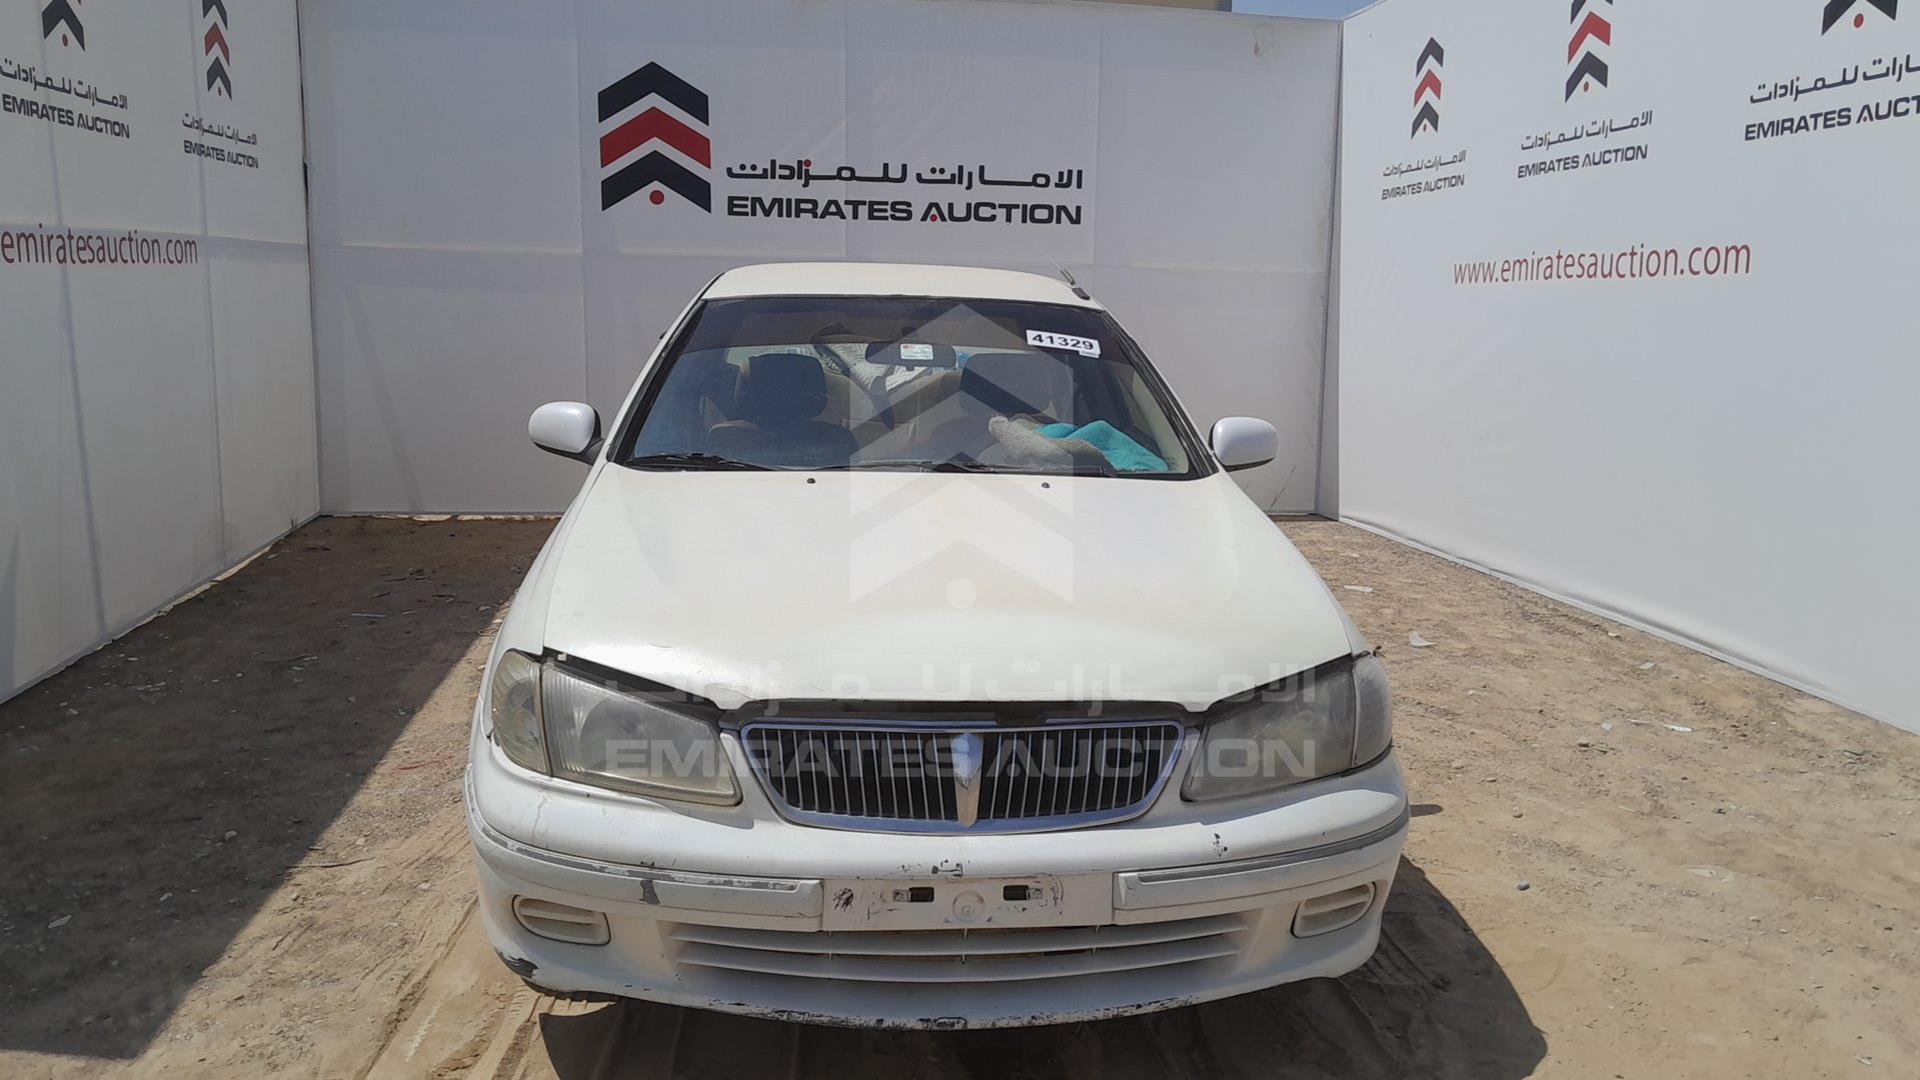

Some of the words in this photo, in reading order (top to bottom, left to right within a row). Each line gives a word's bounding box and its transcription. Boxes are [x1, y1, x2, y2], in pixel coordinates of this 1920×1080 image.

[2, 93, 75, 127] EMIRATES
[77, 112, 130, 139] AUCTION
[1744, 107, 1852, 141] EMIRATES
[184, 139, 225, 161] EMIRATES
[226, 151, 259, 168] AUCTION
[1517, 155, 1580, 179] EMIRATES
[1581, 144, 1648, 168] AUCTION
[726, 159, 908, 188] للمزادات
[916, 165, 1083, 190] الامارات
[1381, 182, 1422, 200] EMIRATES
[1423, 174, 1465, 192] AUCTION
[727, 195, 913, 221] EMIRATES
[920, 201, 1082, 225] AUCTION
[0, 222, 198, 264] emiratesauction.com
[1453, 243, 1751, 284] www.emiratesauction.com
[1032, 334, 1094, 350] 41329
